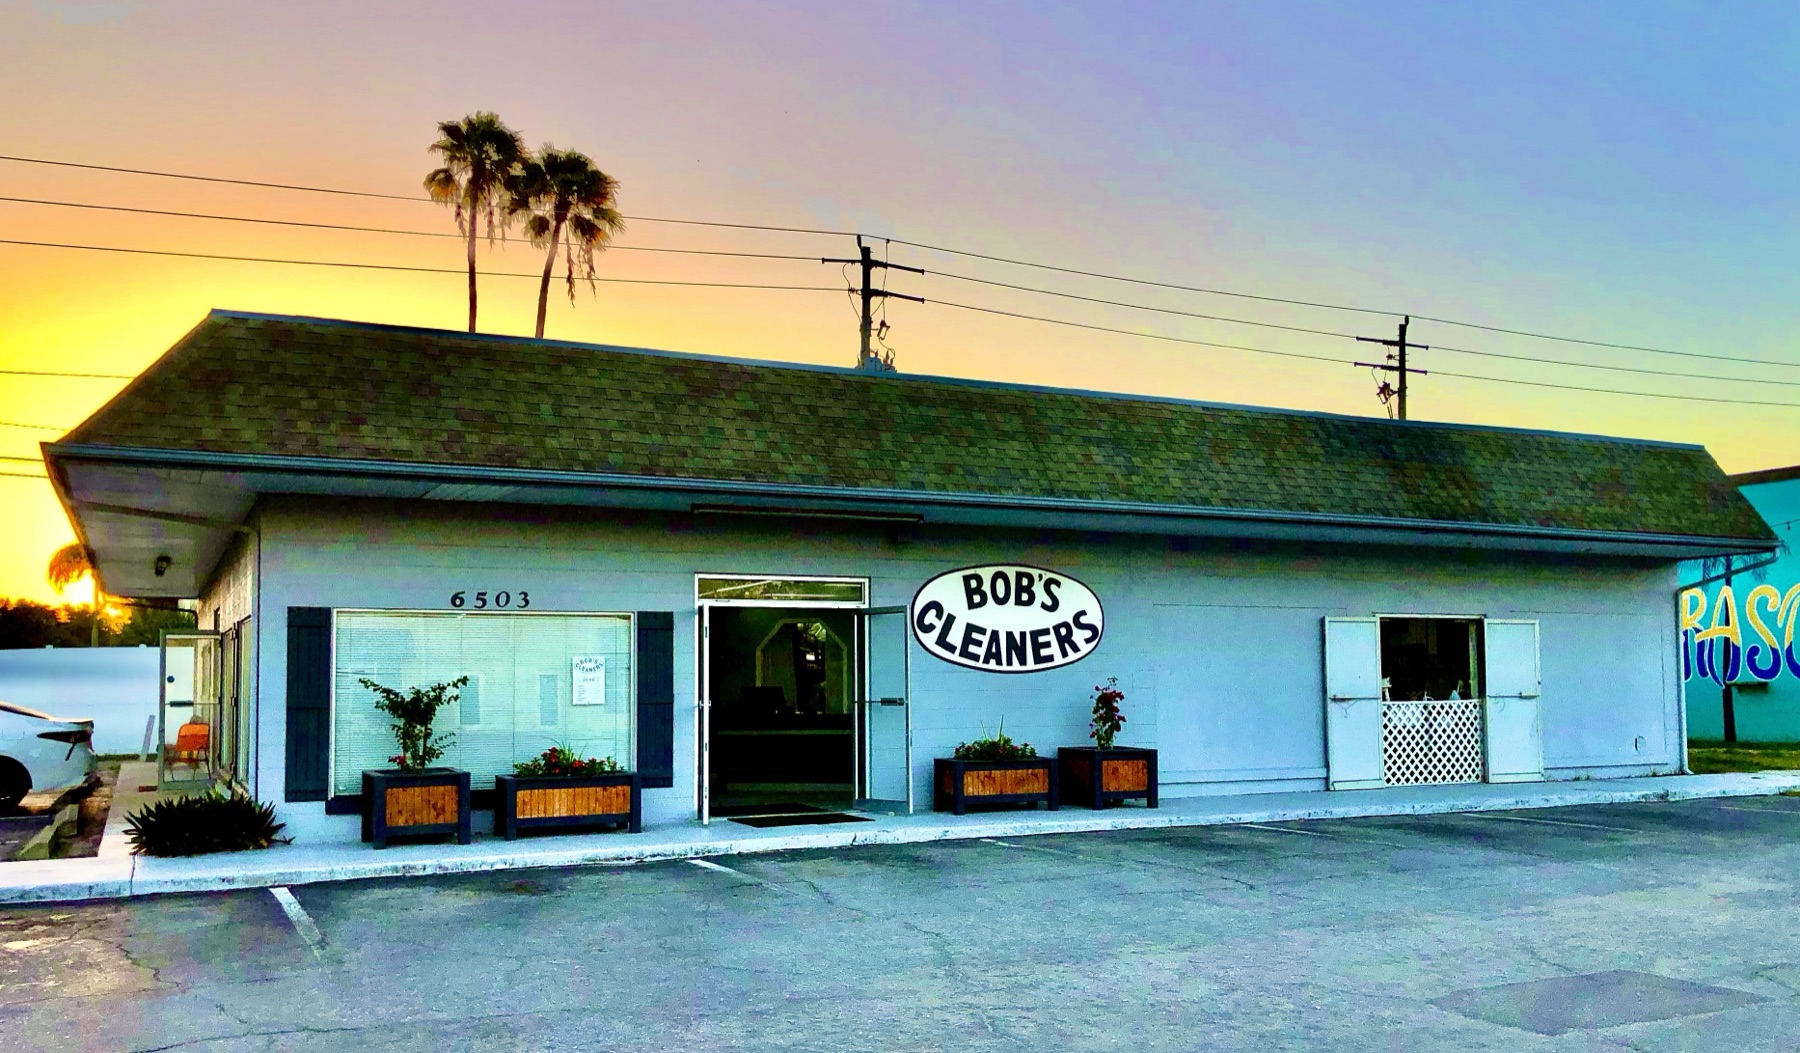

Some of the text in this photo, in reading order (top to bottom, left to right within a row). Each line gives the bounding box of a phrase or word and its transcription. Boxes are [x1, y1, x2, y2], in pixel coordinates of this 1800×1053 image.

[450, 590, 531, 609] 6503
[962, 570, 1062, 613] BOB'S
[916, 600, 1100, 667] CLEANERS
